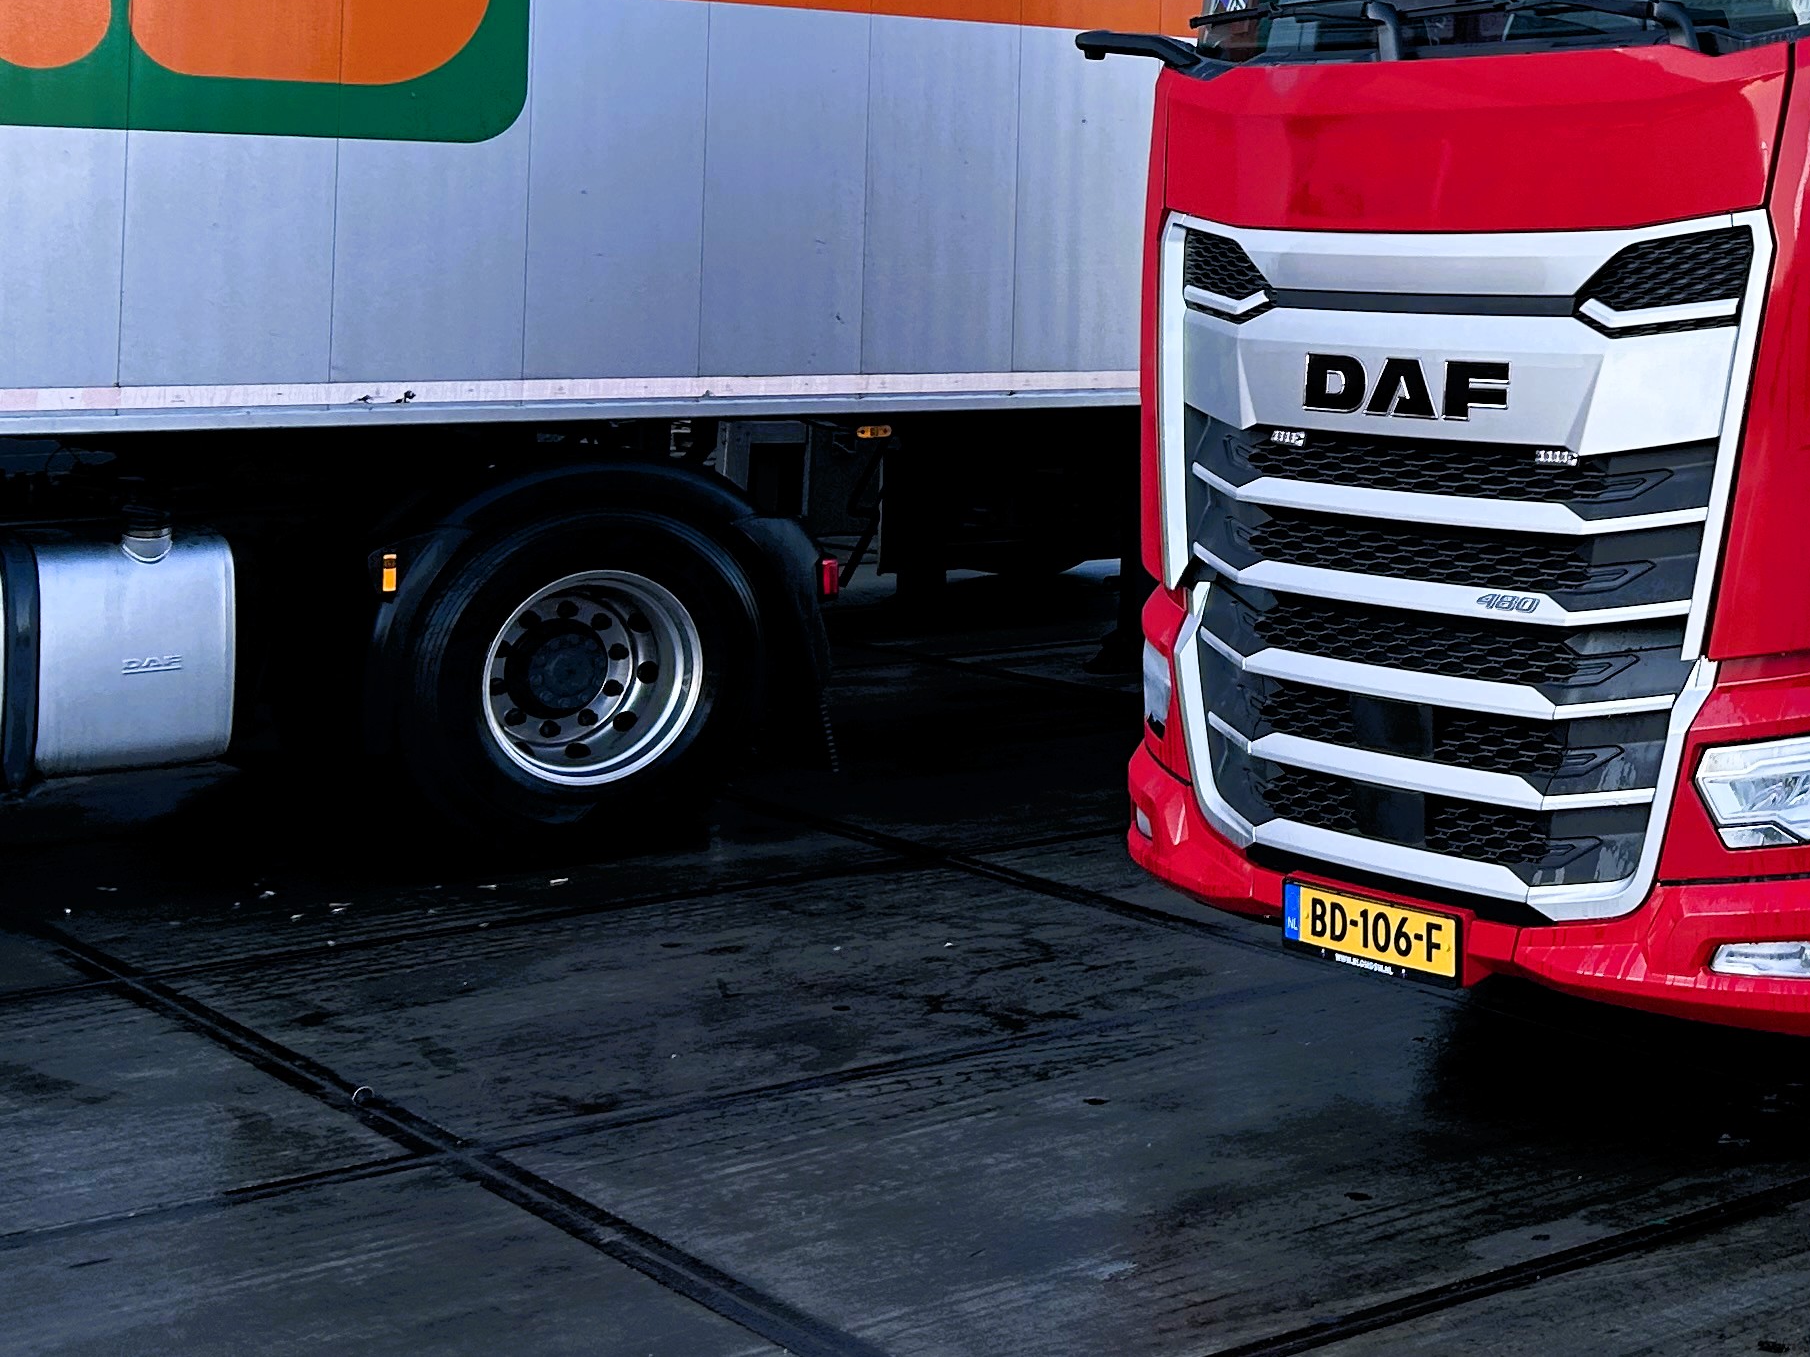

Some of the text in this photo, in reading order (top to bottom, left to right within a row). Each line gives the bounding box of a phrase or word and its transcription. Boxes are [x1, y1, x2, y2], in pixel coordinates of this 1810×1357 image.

[1302, 351, 1511, 421] DAF
[1476, 593, 1541, 614] 480
[1287, 916, 1298, 931] NL
[1310, 897, 1443, 963] BD-106-F
